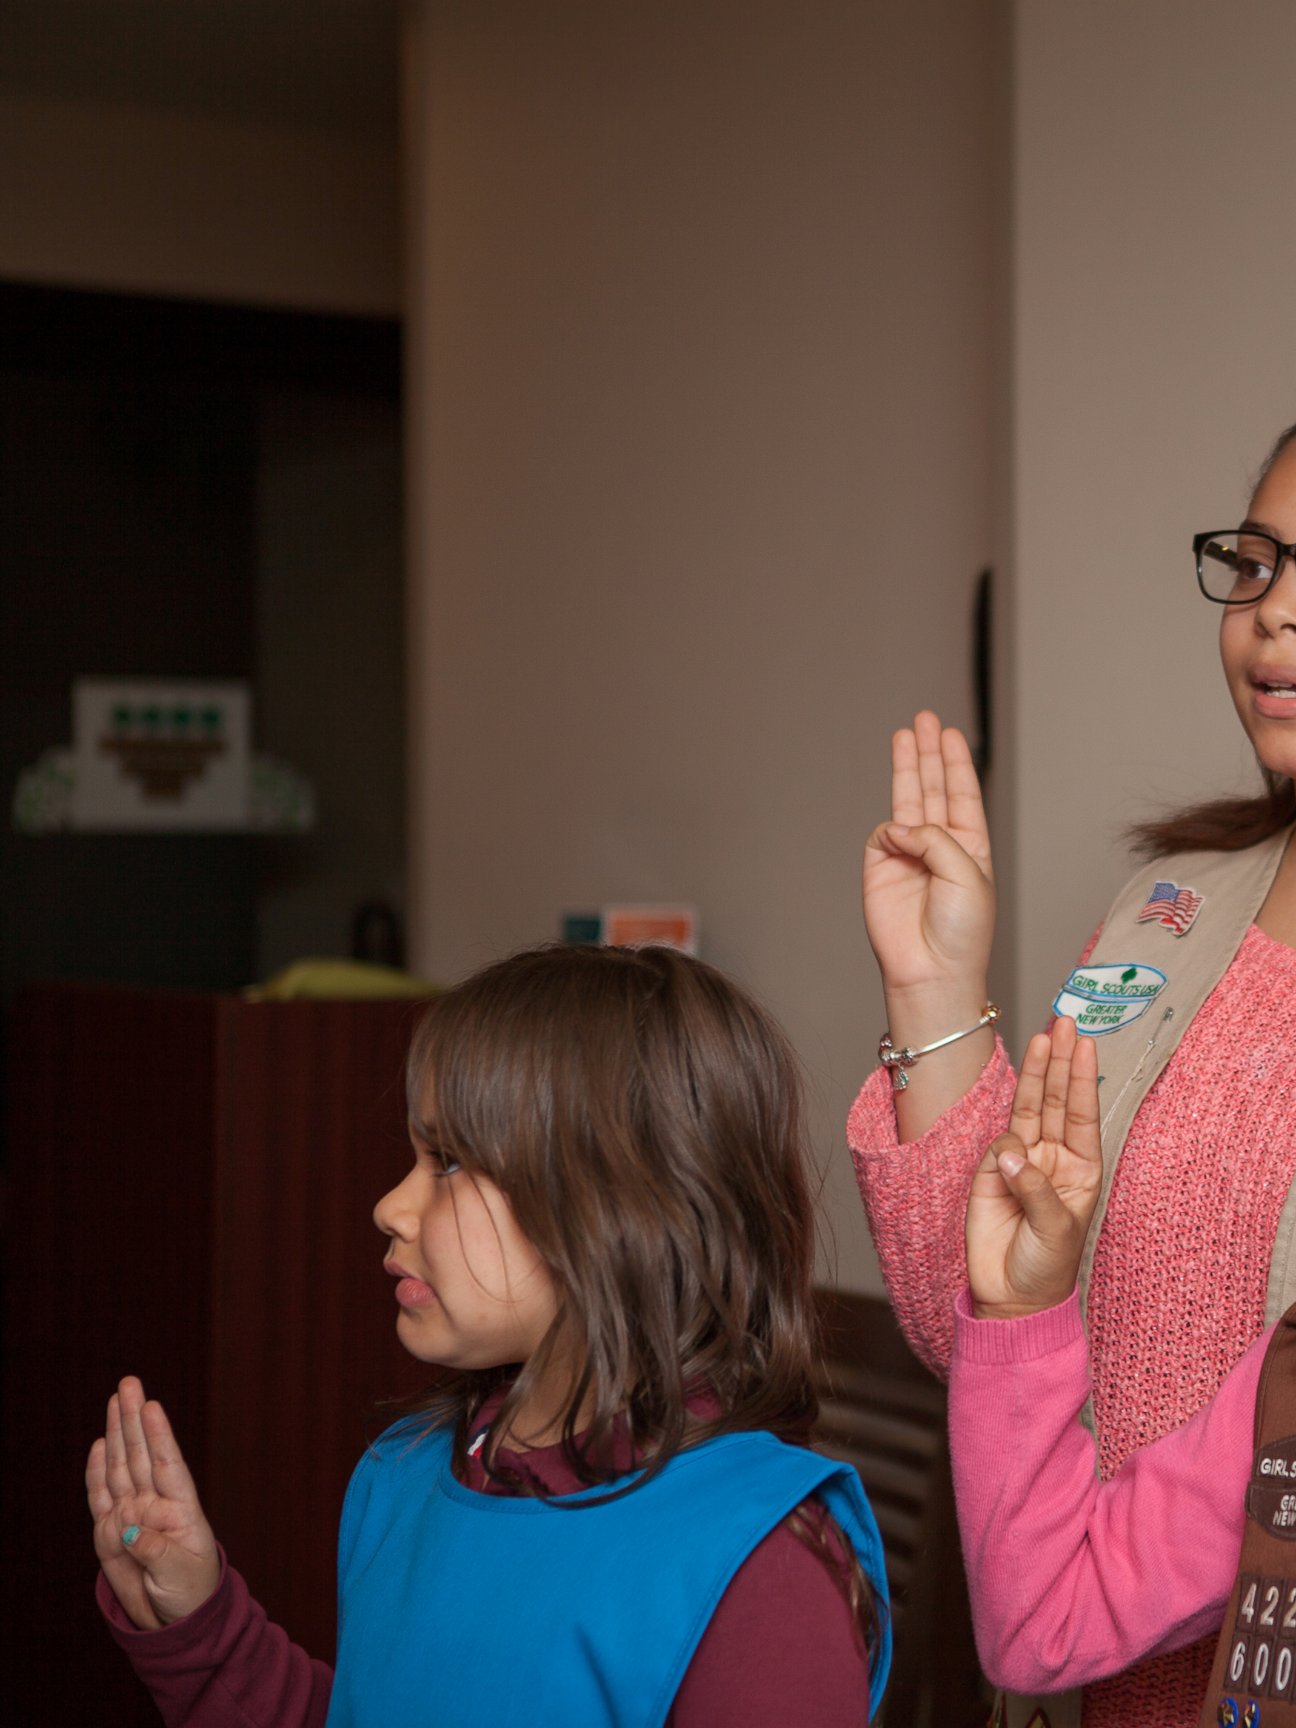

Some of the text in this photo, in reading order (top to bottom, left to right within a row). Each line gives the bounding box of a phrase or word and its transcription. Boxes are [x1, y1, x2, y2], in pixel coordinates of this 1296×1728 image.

[1072, 975, 1160, 995] GIRL SCOUTS USA
[1086, 1004, 1127, 1014] GREATER
[1076, 1014, 1124, 1025] NEW YORK
[1260, 1458, 1289, 1477] GIRL
